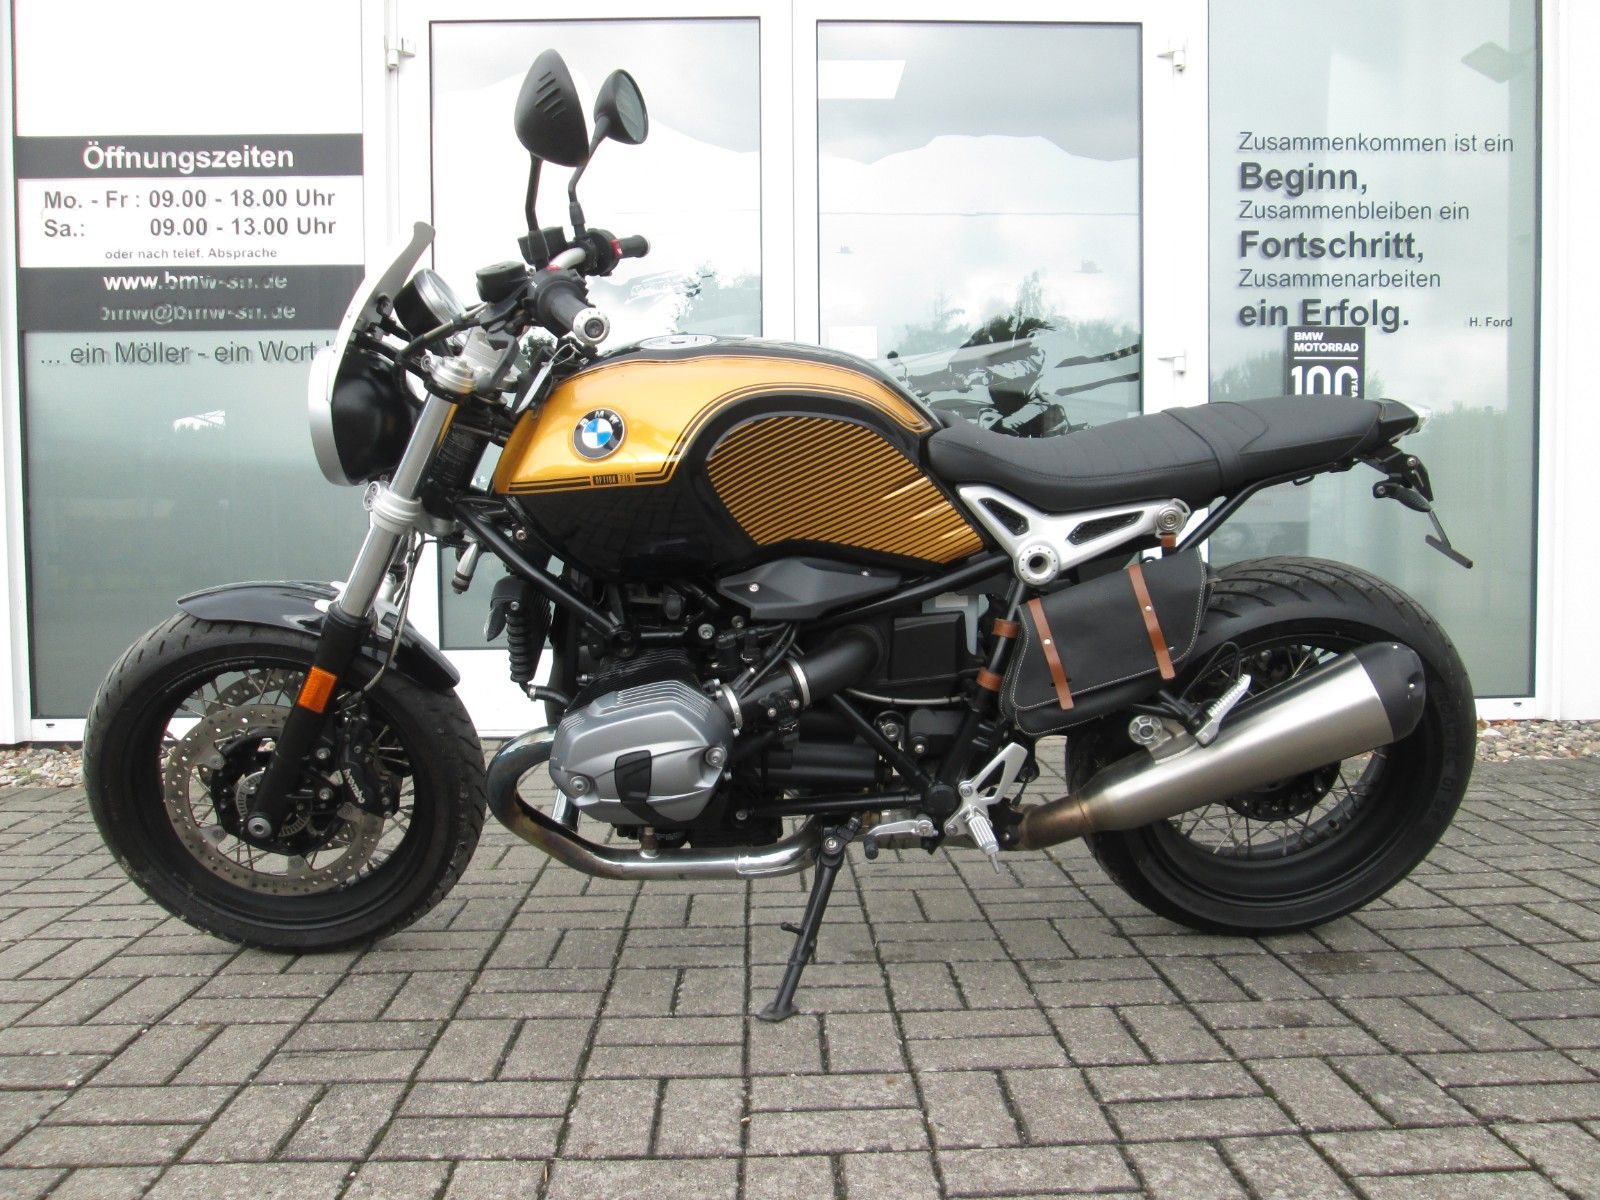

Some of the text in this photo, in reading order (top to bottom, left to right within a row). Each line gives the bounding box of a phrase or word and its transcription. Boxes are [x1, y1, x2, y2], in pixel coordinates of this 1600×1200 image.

[1239, 131, 1514, 152] Zusammenkommen ist ein
[83, 141, 295, 174] Öffnungszeiten
[1240, 161, 1368, 197] Beginn,
[44, 190, 82, 209] Mo.
[149, 189, 207, 208] 09.00
[230, 188, 288, 207] 18.00
[296, 188, 336, 207] Uhr
[1239, 200, 1469, 220] Zusammenbleiben ein
[44, 218, 85, 237] Sa.:
[150, 218, 208, 236] 09.00
[231, 217, 289, 235] 13.00
[297, 216, 337, 235] Uhr
[105, 247, 278, 260] oder nach telef. Absprache
[1240, 230, 1424, 263] Fortschritt,
[1239, 268, 1441, 288] Zusammenarbeiten
[1239, 298, 1513, 334] ein Erfolg. H. Ford
[1294, 331, 1324, 341] BMW
[70, 342, 105, 364] ein
[115, 341, 190, 363] Möller
[214, 341, 250, 361] ein
[259, 340, 316, 361] Wort
[1294, 342, 1359, 352] MOTORRAD
[1351, 378, 1359, 398] YEA
[579, 410, 620, 427] BMW
